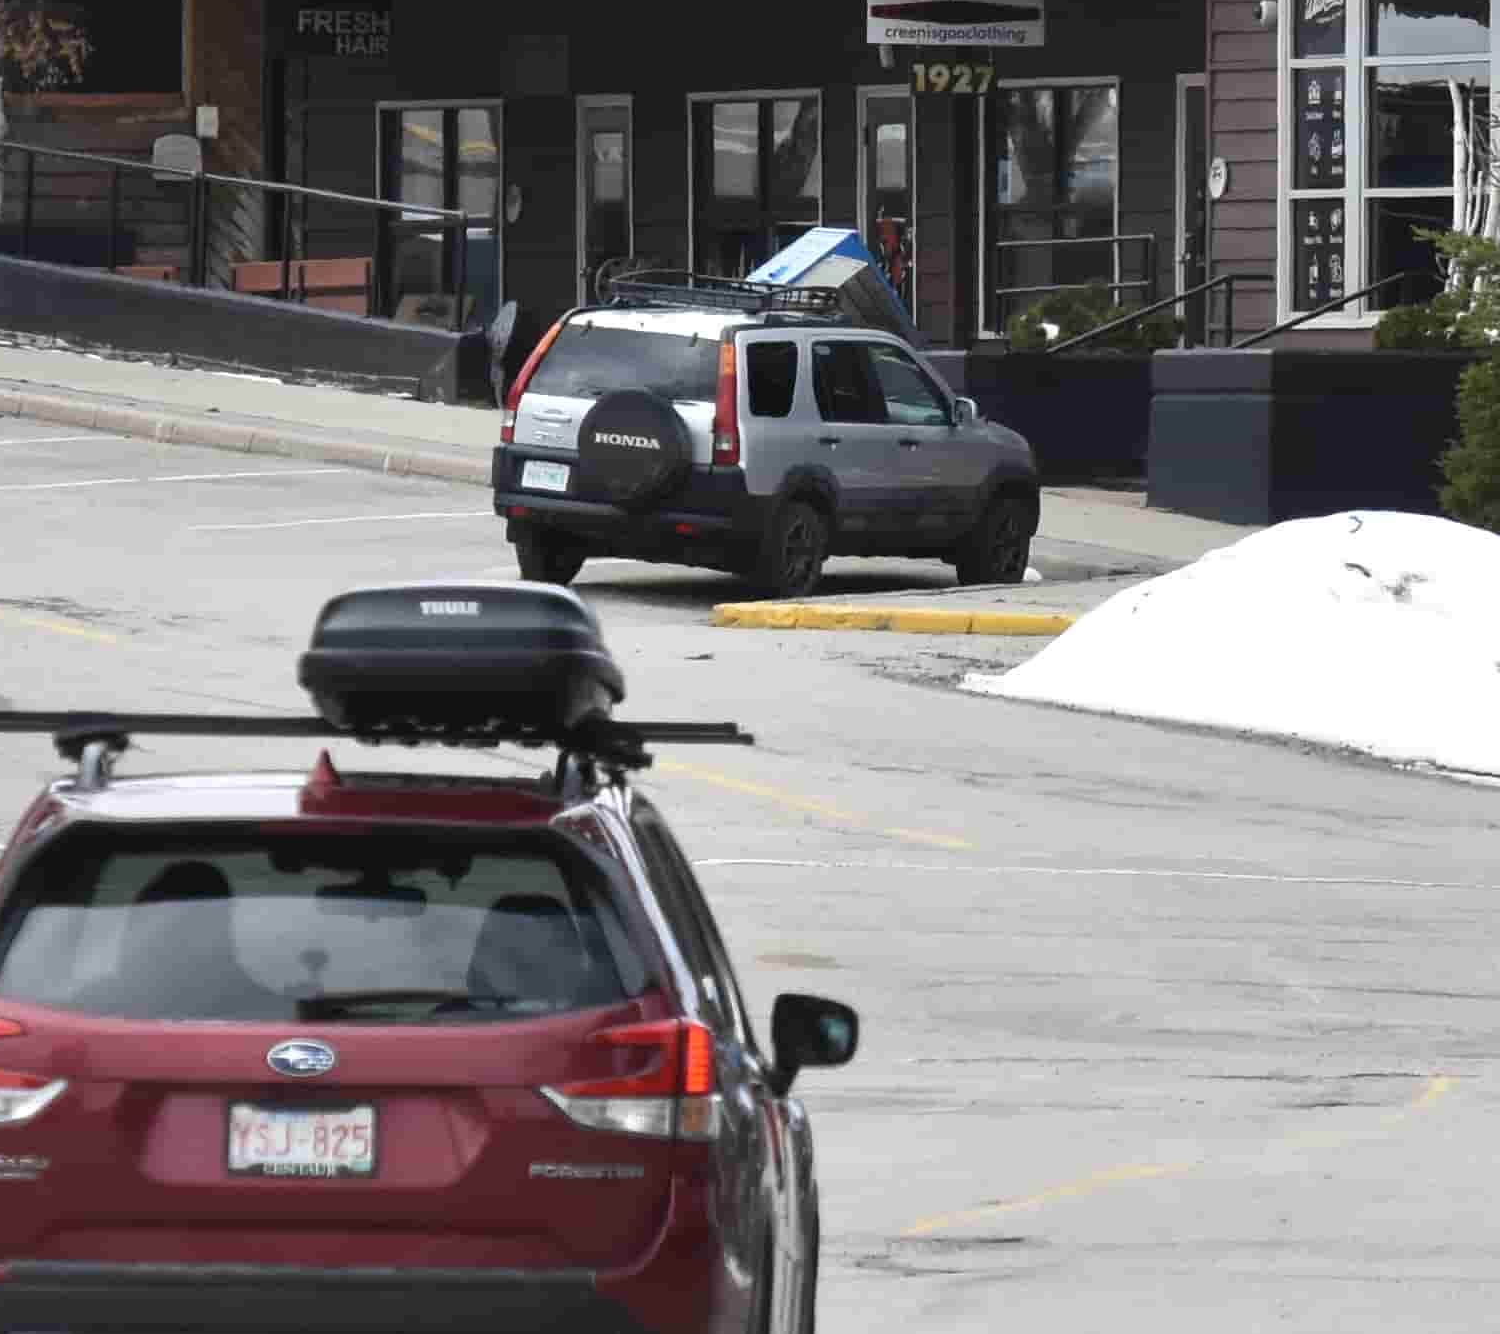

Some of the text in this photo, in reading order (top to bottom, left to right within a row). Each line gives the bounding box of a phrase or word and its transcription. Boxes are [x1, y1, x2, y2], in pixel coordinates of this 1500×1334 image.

[297, 10, 389, 34] FRESH
[335, 34, 389, 55] HAIR
[913, 64, 994, 93] 1927
[593, 431, 661, 451] HONDA
[419, 600, 481, 616] THULE
